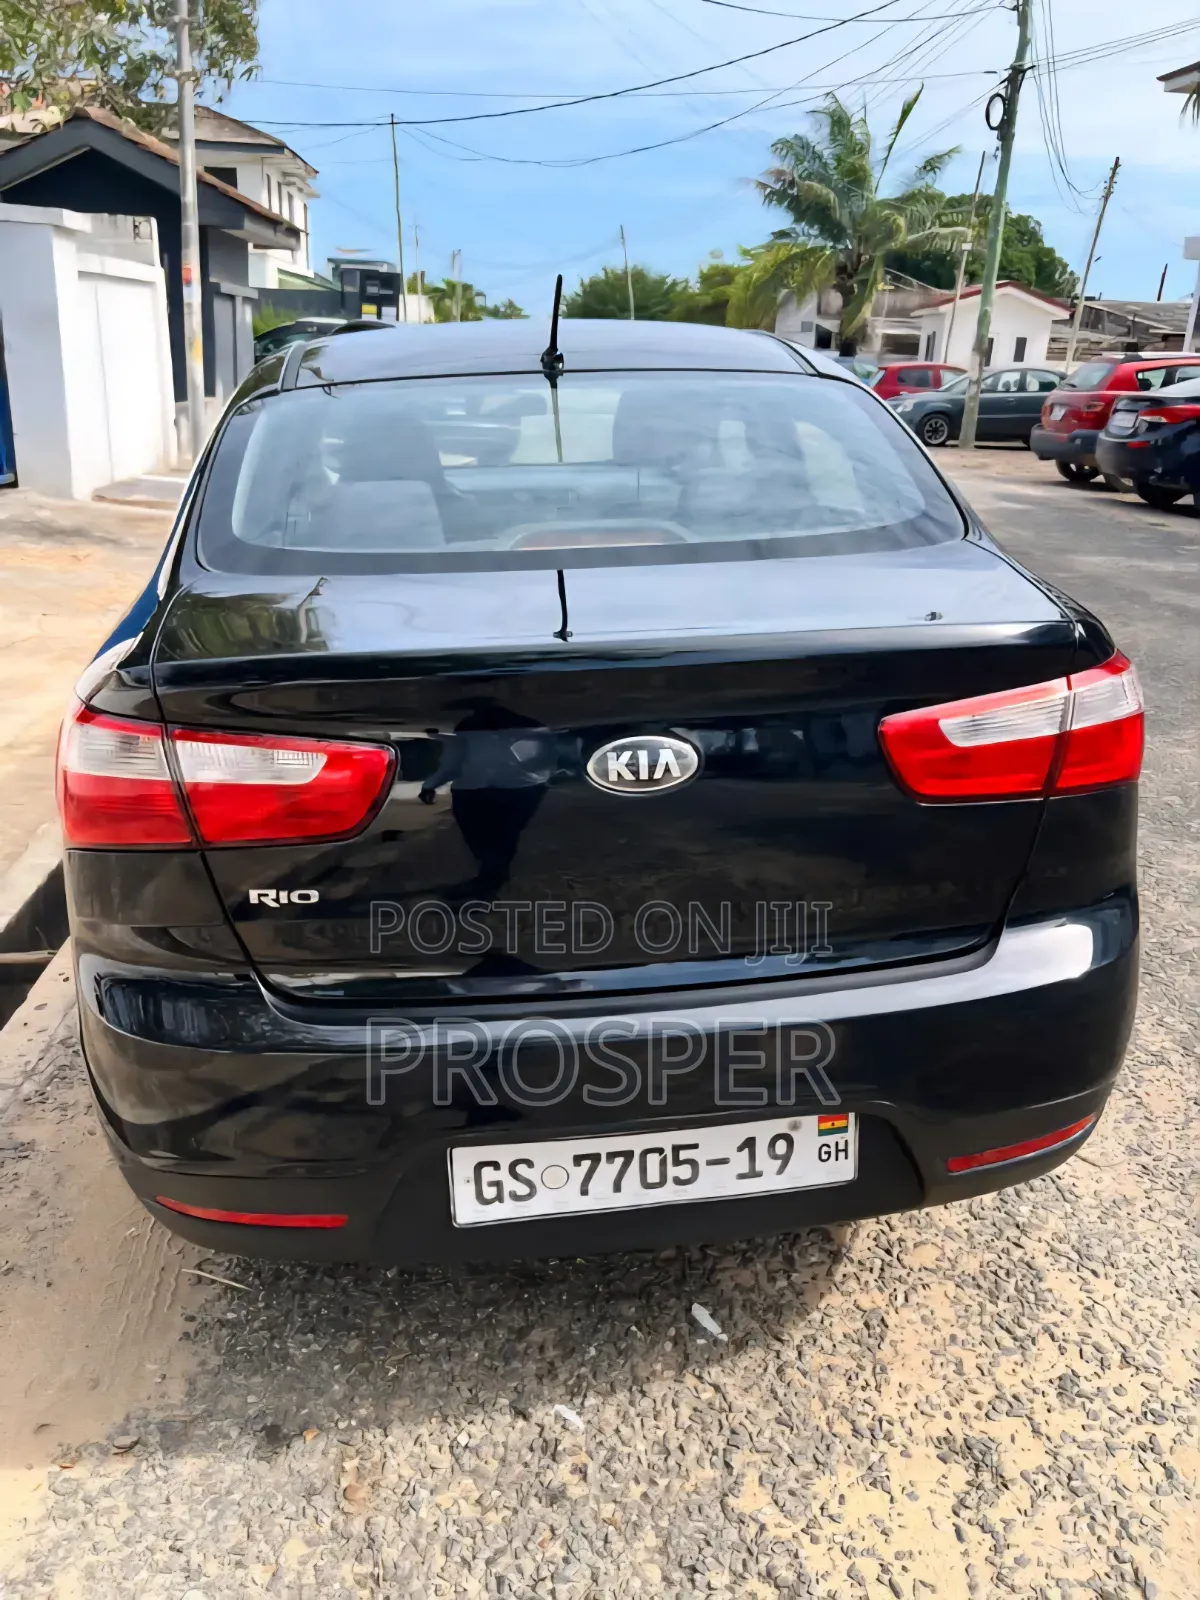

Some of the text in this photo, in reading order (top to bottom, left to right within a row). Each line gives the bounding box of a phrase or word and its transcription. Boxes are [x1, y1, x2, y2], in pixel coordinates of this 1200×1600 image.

[606, 748, 682, 782] KIA
[248, 888, 320, 908] RIO
[817, 1138, 849, 1163] GH
[473, 1132, 796, 1206] GS 7705-19
